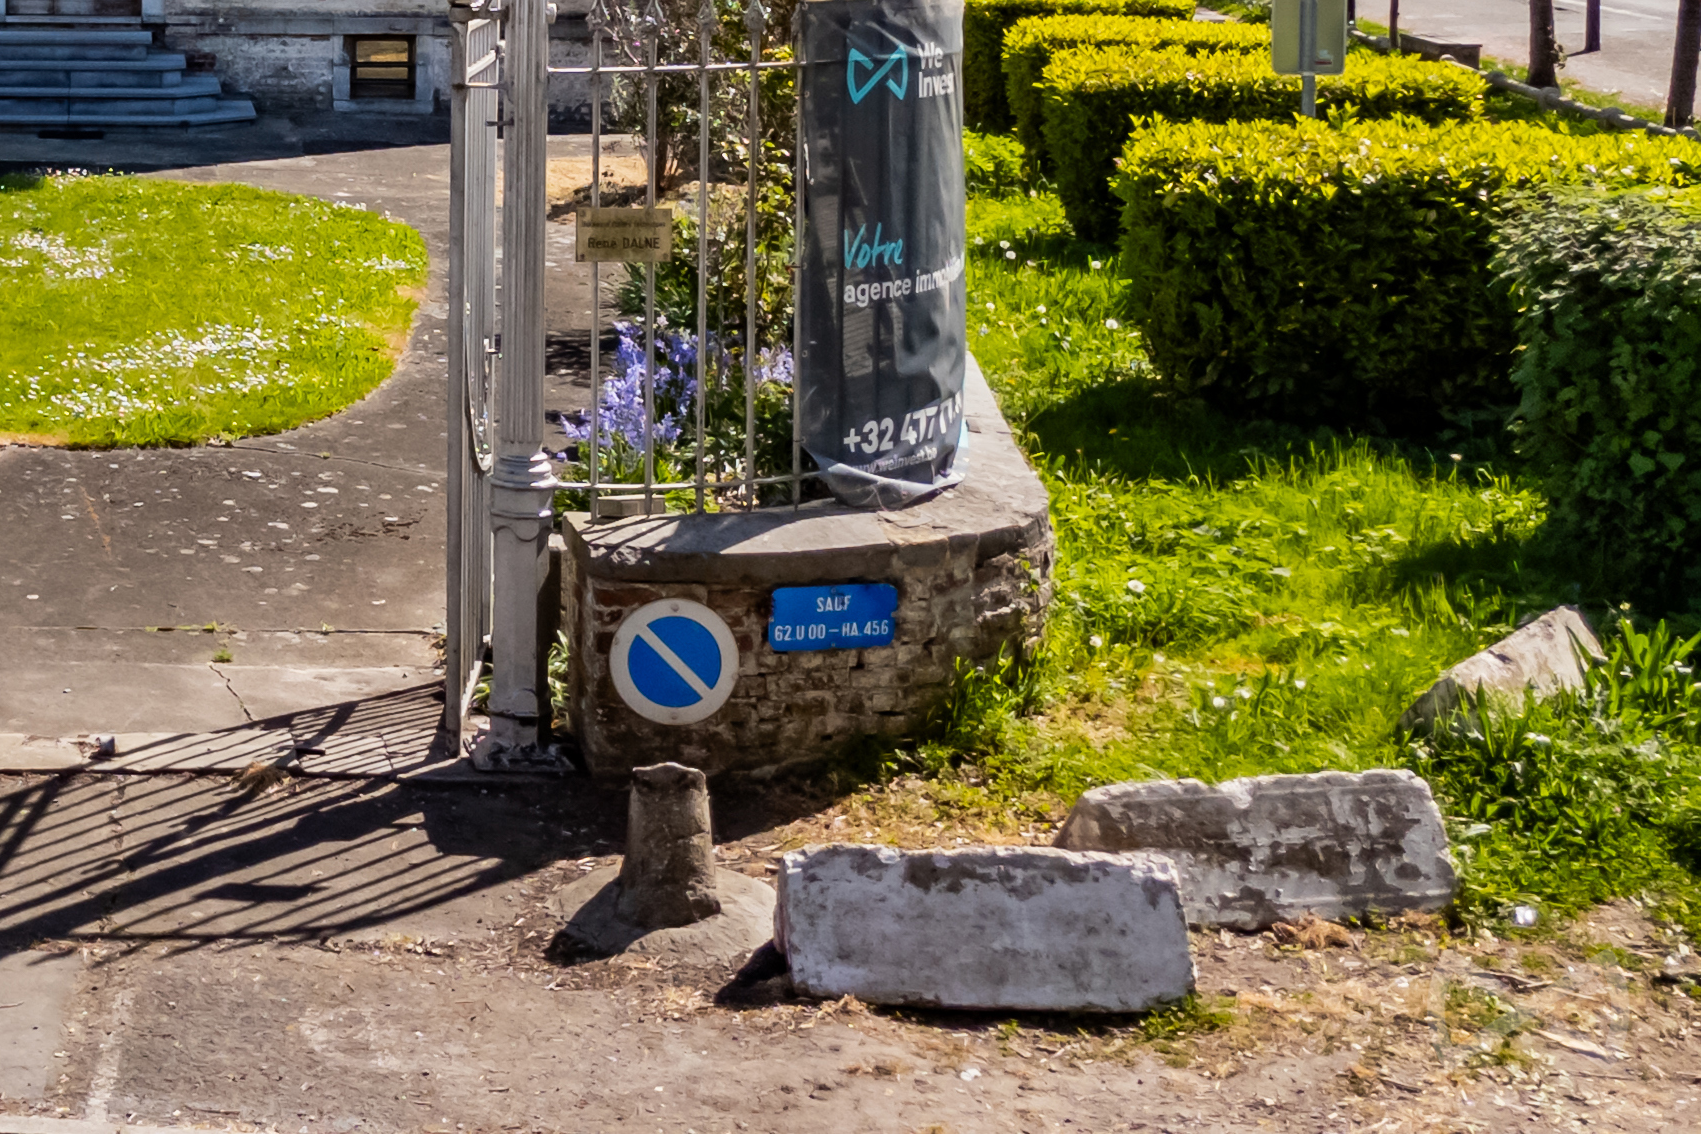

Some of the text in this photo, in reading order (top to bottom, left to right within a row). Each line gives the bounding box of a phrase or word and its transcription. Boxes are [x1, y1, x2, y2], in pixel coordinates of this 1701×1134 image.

[916, 41, 943, 69] We
[844, 222, 904, 269] Votre
[843, 278, 912, 307] agence
[843, 417, 894, 454] +32
[816, 595, 852, 612] SAUF
